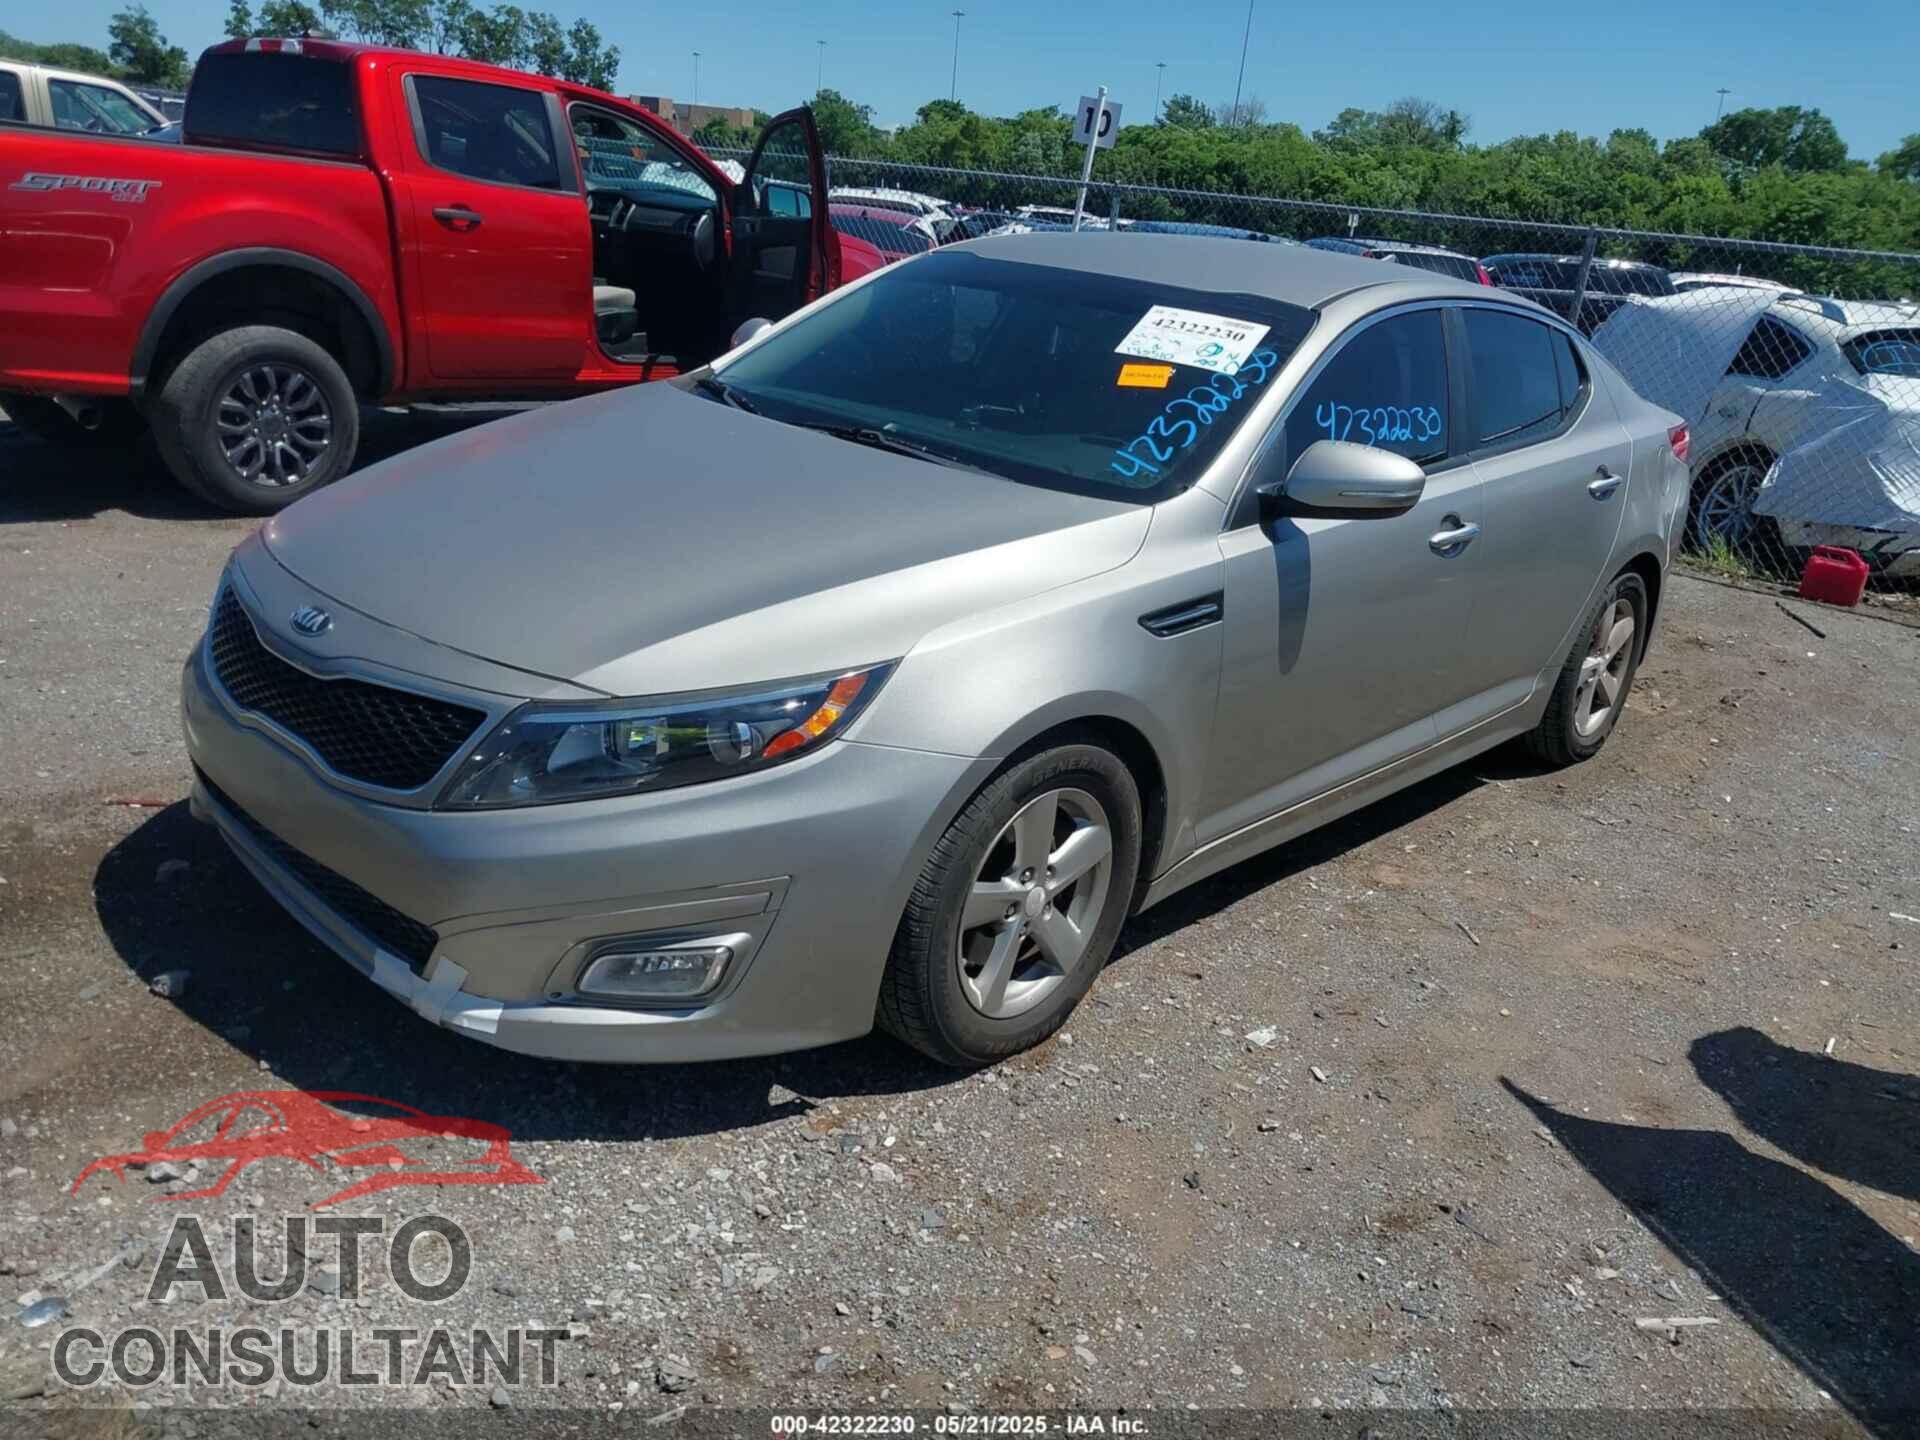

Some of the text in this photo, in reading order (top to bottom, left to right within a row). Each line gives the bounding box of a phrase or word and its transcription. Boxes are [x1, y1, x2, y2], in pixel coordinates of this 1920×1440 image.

[8, 172, 162, 193] SPORT
[1152, 317, 1247, 342] 42322230
[1111, 351, 1277, 476] 42322230
